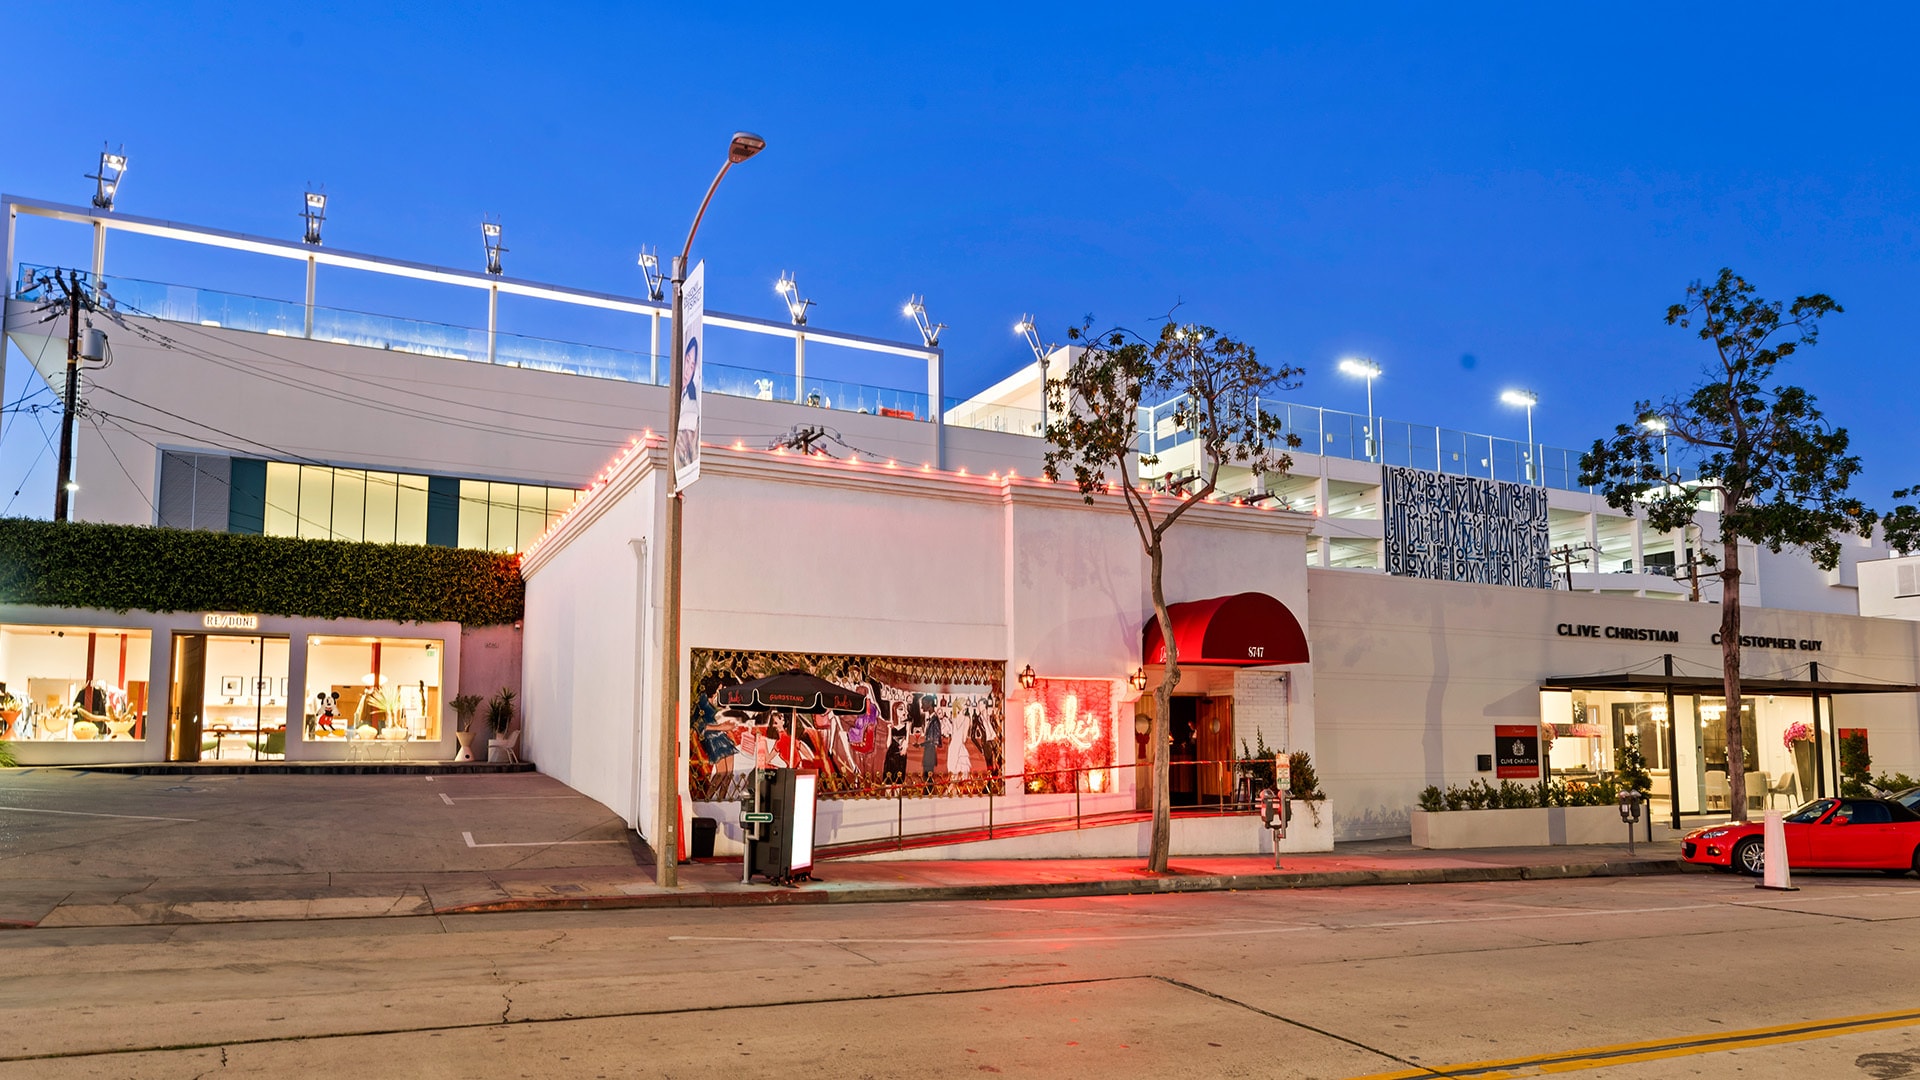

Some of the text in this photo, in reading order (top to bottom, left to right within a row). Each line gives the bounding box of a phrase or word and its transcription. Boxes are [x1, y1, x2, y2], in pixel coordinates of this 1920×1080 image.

[206, 615, 257, 627] RE/DONE
[1557, 623, 1679, 642] CLIVE CHRISTIAN
[1711, 633, 1822, 651] CISTOPHER GUY
[1248, 646, 1264, 657] 8747
[1024, 694, 1100, 749] Drake's
